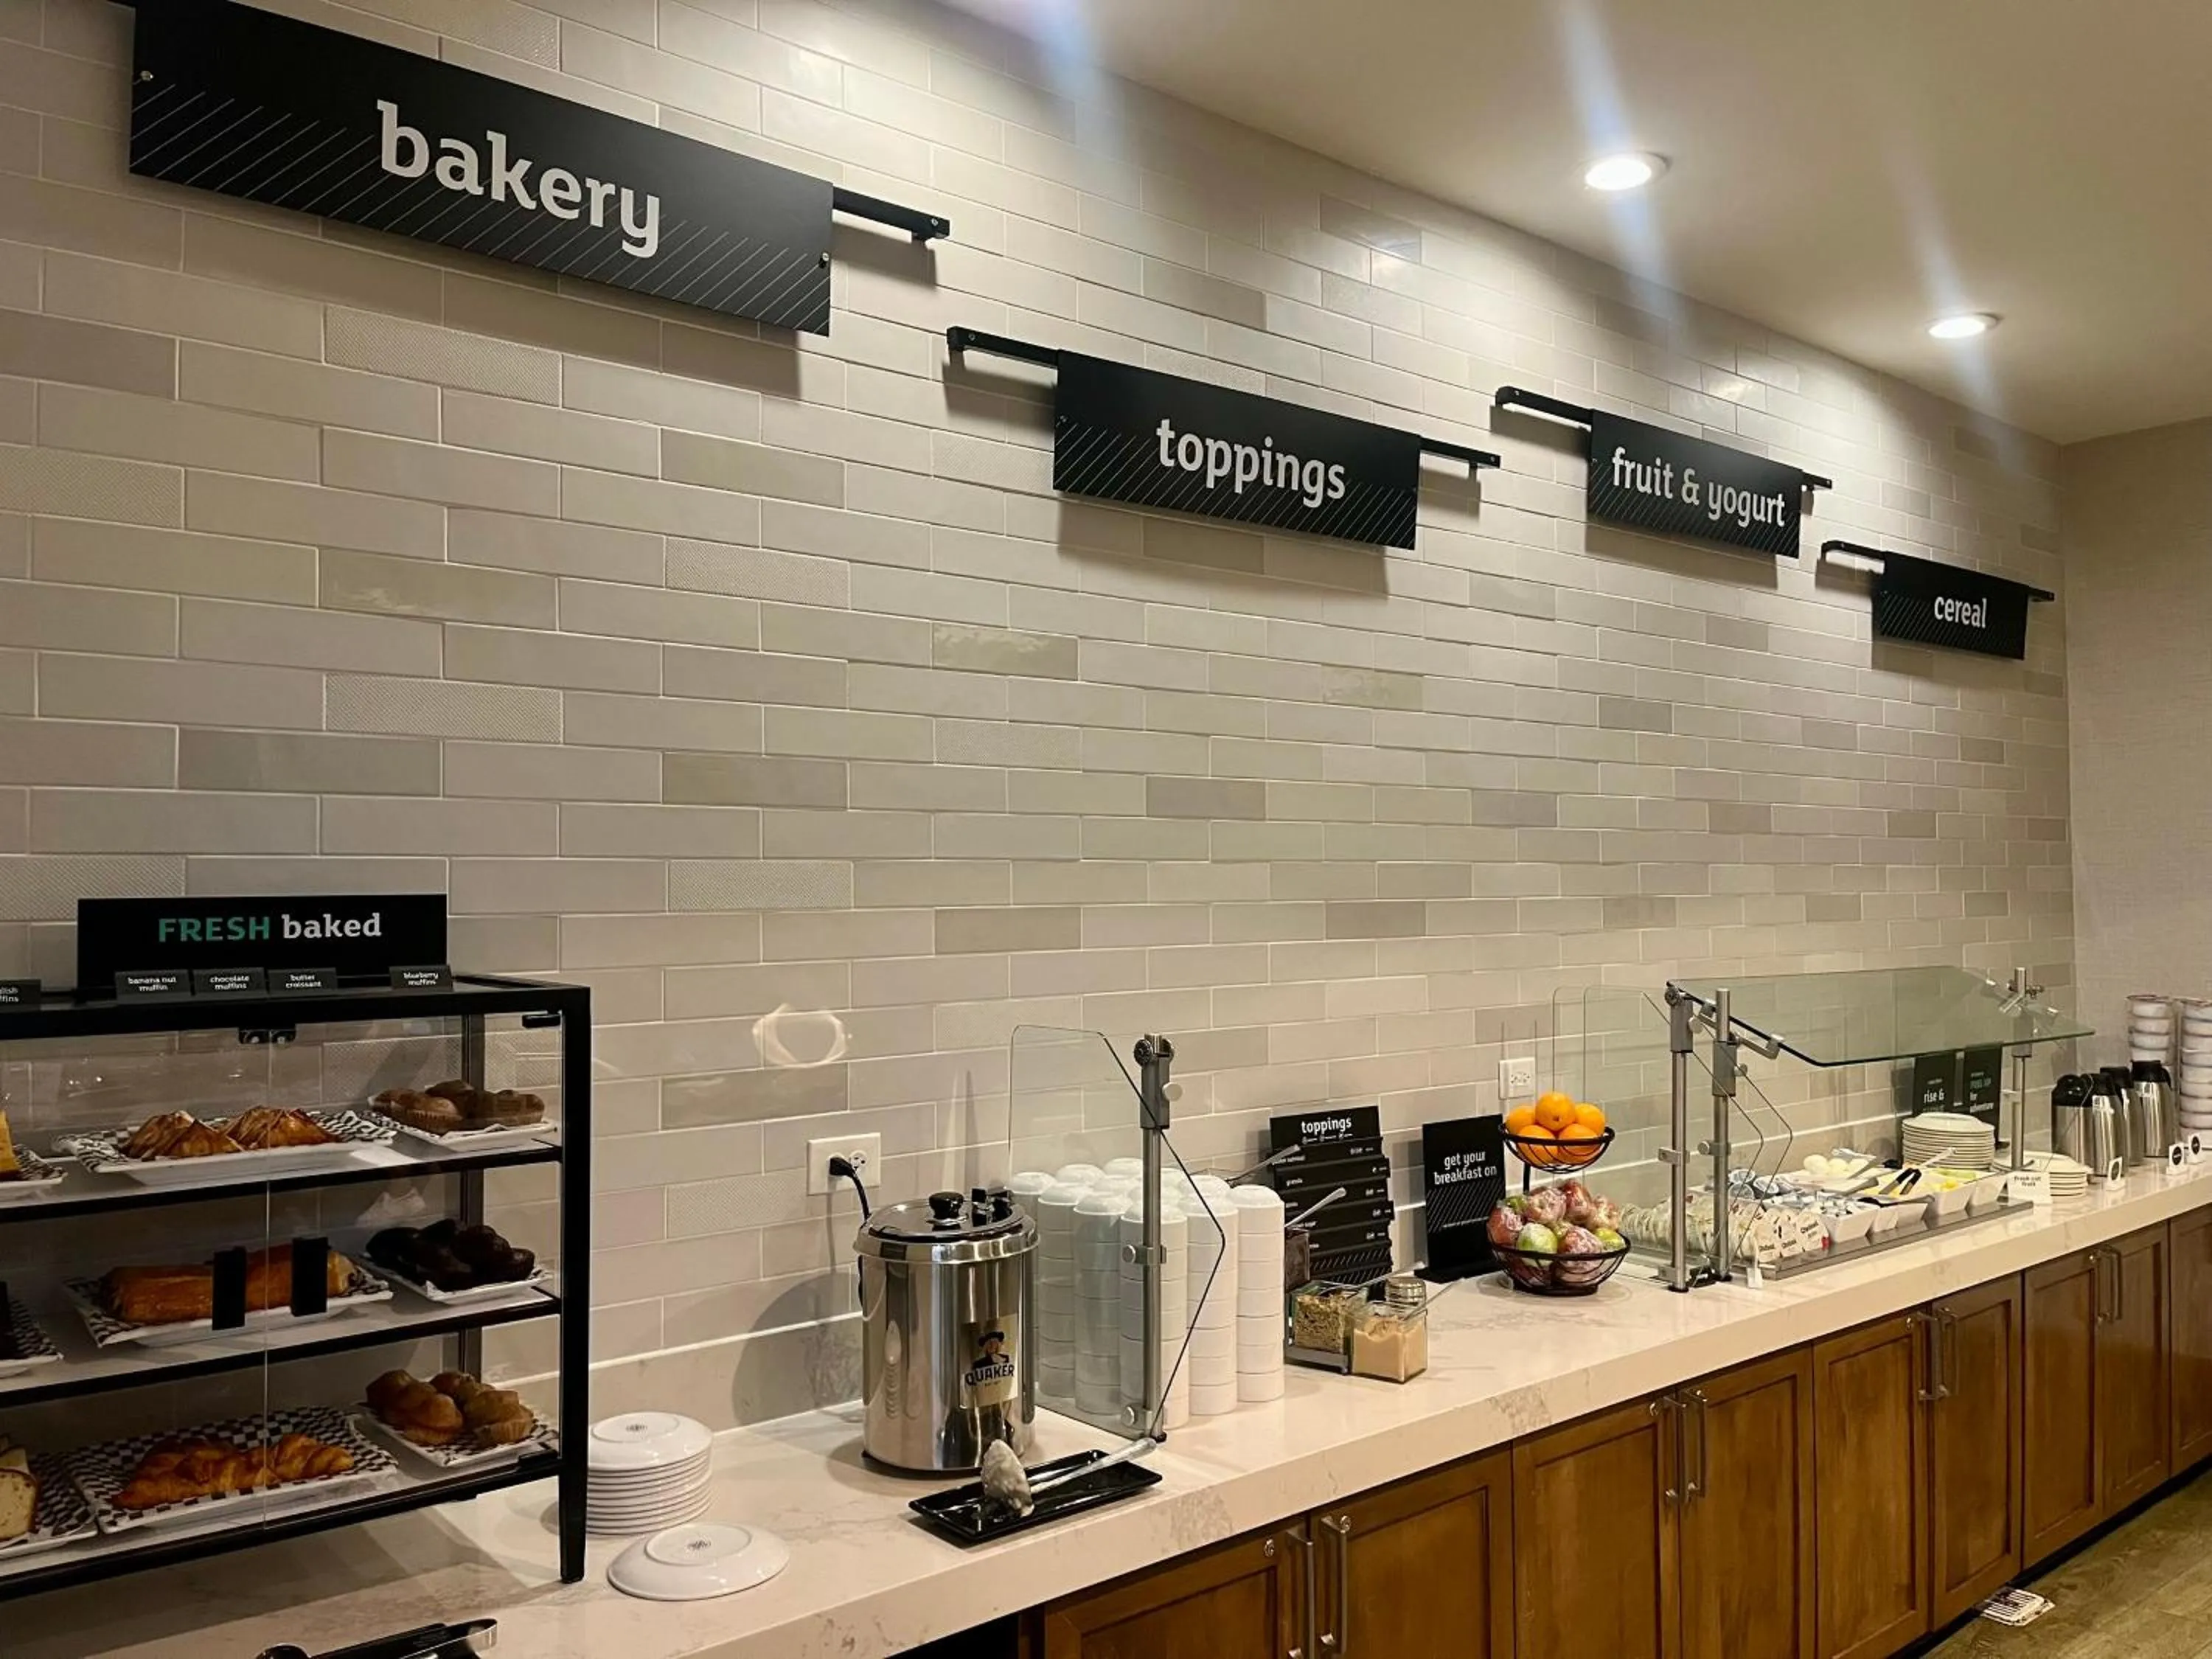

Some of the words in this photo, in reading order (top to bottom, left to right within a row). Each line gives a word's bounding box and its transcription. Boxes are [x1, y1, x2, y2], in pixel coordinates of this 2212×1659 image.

[377, 100, 660, 258] bakery
[1156, 419, 1346, 508] toppings
[1612, 446, 1674, 499] fruit
[1681, 468, 1700, 505] &
[1708, 481, 1785, 527] yogurt
[1934, 597, 1987, 628] cereal
[159, 917, 270, 942] FRESH
[282, 912, 382, 939] baked
[209, 975, 250, 983] chocolate
[1924, 1089, 1937, 1103] rise
[1301, 1116, 1352, 1135] toppings
[1444, 1152, 1461, 1170] get
[1463, 1152, 1486, 1167] your
[1433, 1166, 1482, 1185] breakfast
[1484, 1166, 1498, 1177] on
[965, 1364, 1015, 1386] QUAKER
